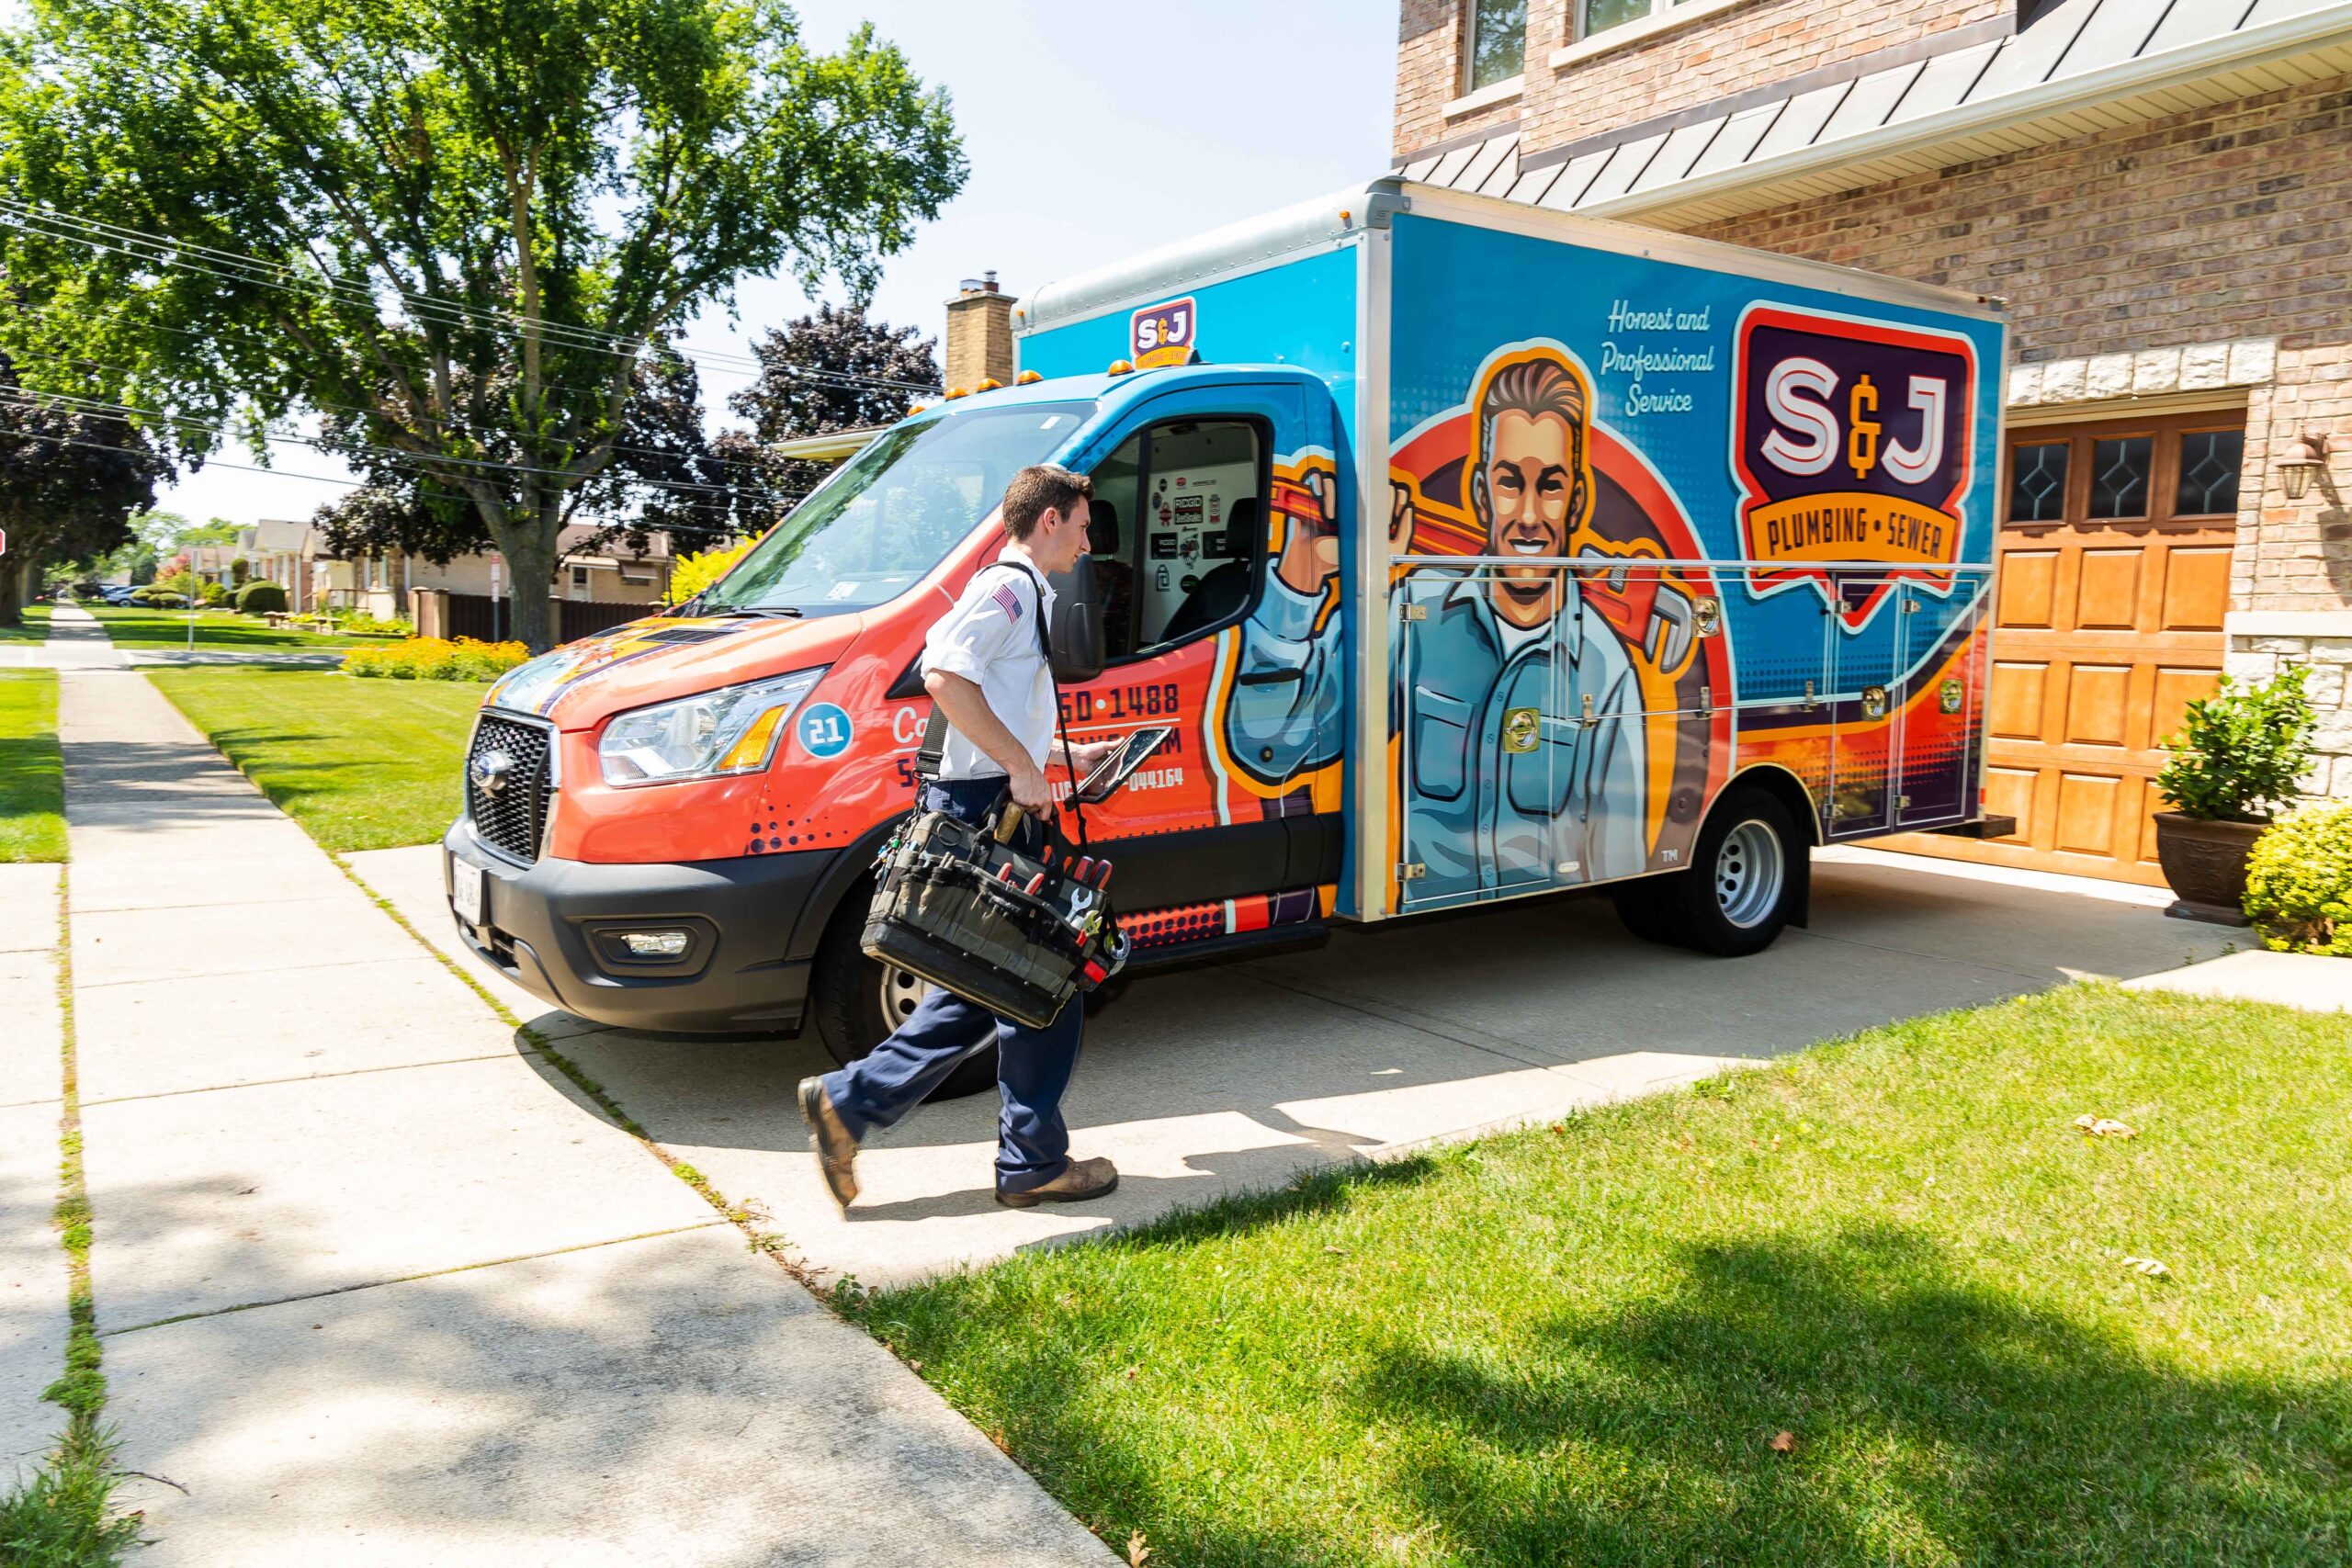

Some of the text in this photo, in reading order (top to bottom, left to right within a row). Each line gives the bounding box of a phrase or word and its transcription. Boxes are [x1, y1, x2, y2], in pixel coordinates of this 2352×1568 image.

[1136, 310, 1187, 349] S&J
[1608, 299, 1710, 333] Honest and
[1600, 341, 1714, 381] Professional
[1624, 383, 1693, 416] Service
[1760, 356, 1947, 485] S&J
[1767, 507, 1942, 558] PLUMBING SEWER
[808, 716, 843, 745] 21
[1661, 849, 1679, 862] TM
